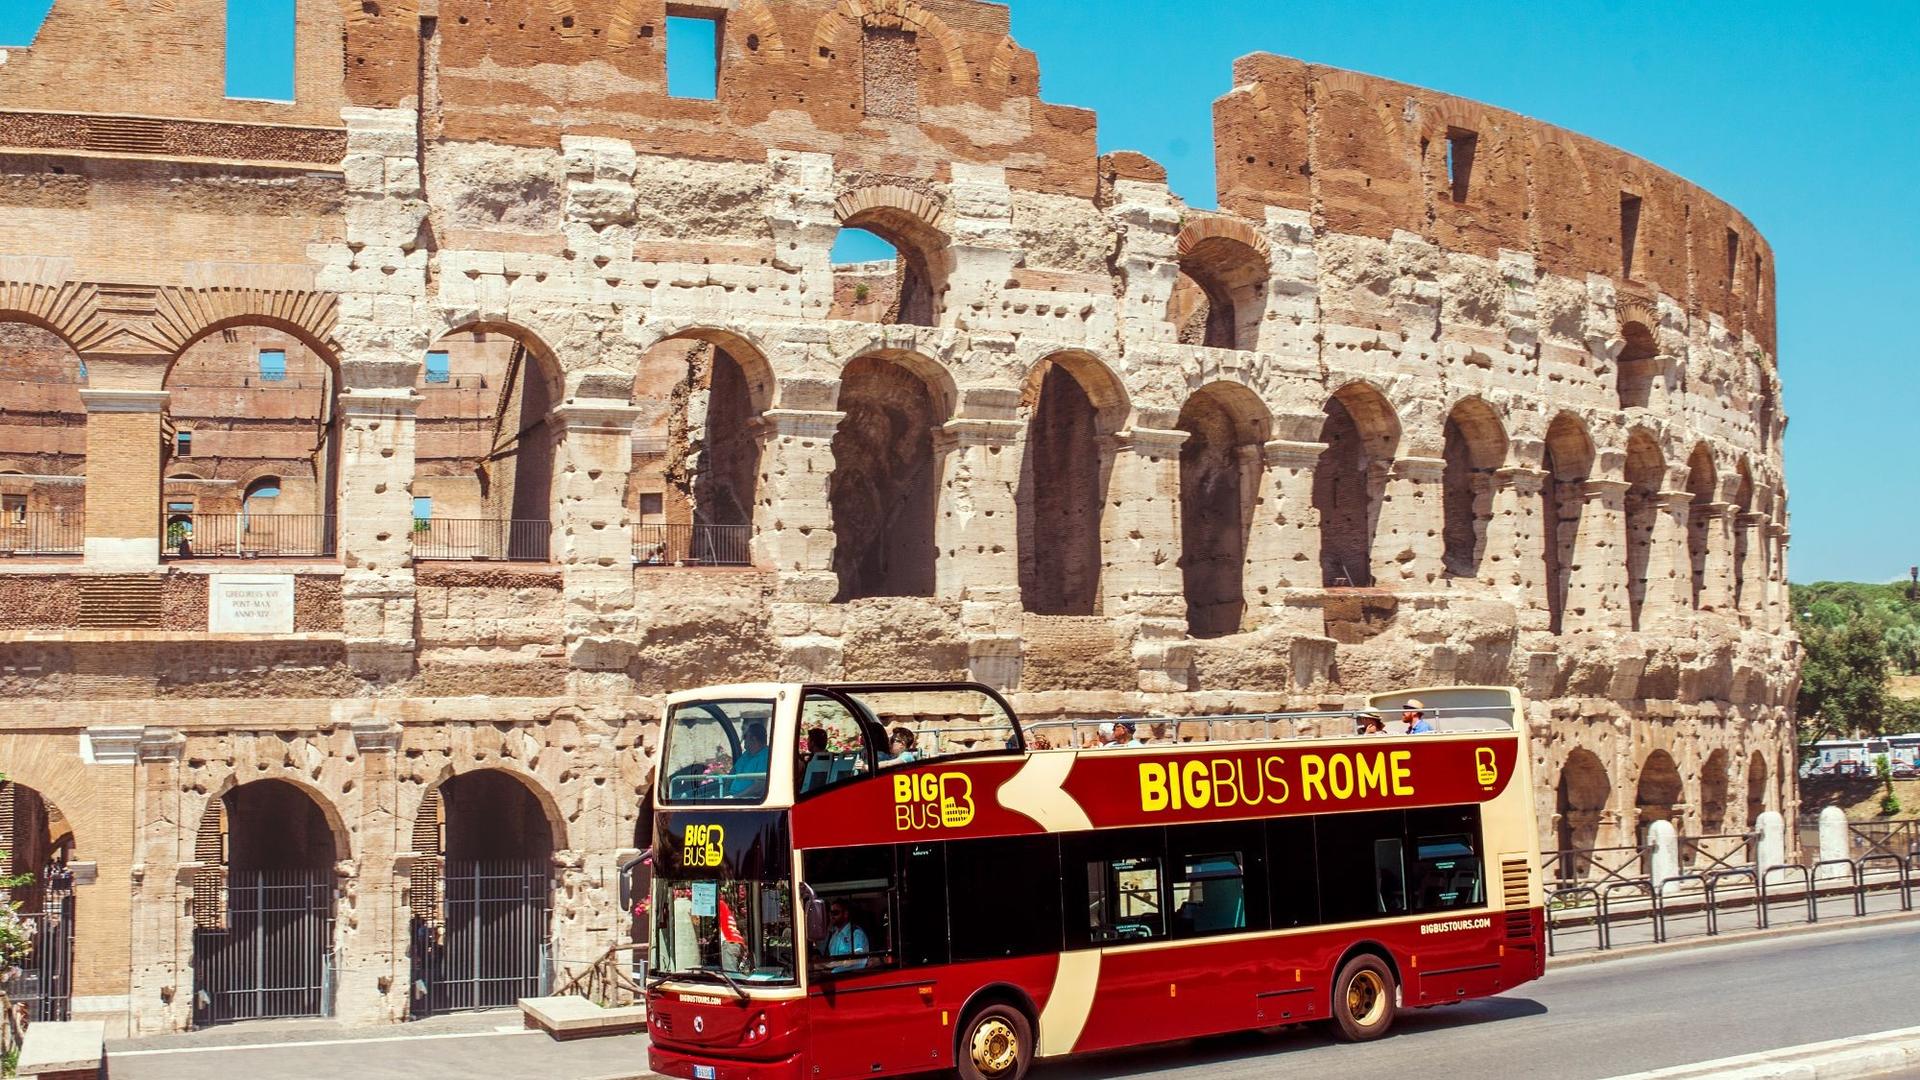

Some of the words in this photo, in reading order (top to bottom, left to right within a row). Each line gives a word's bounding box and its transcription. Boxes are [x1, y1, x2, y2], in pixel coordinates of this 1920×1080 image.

[893, 773, 939, 803] BIG
[1300, 750, 1415, 802] ROME
[895, 803, 941, 831] BUS
[684, 824, 706, 846] BIG
[683, 846, 706, 867] BUS
[1420, 917, 1491, 935] BIGBUSTOURS.COM
